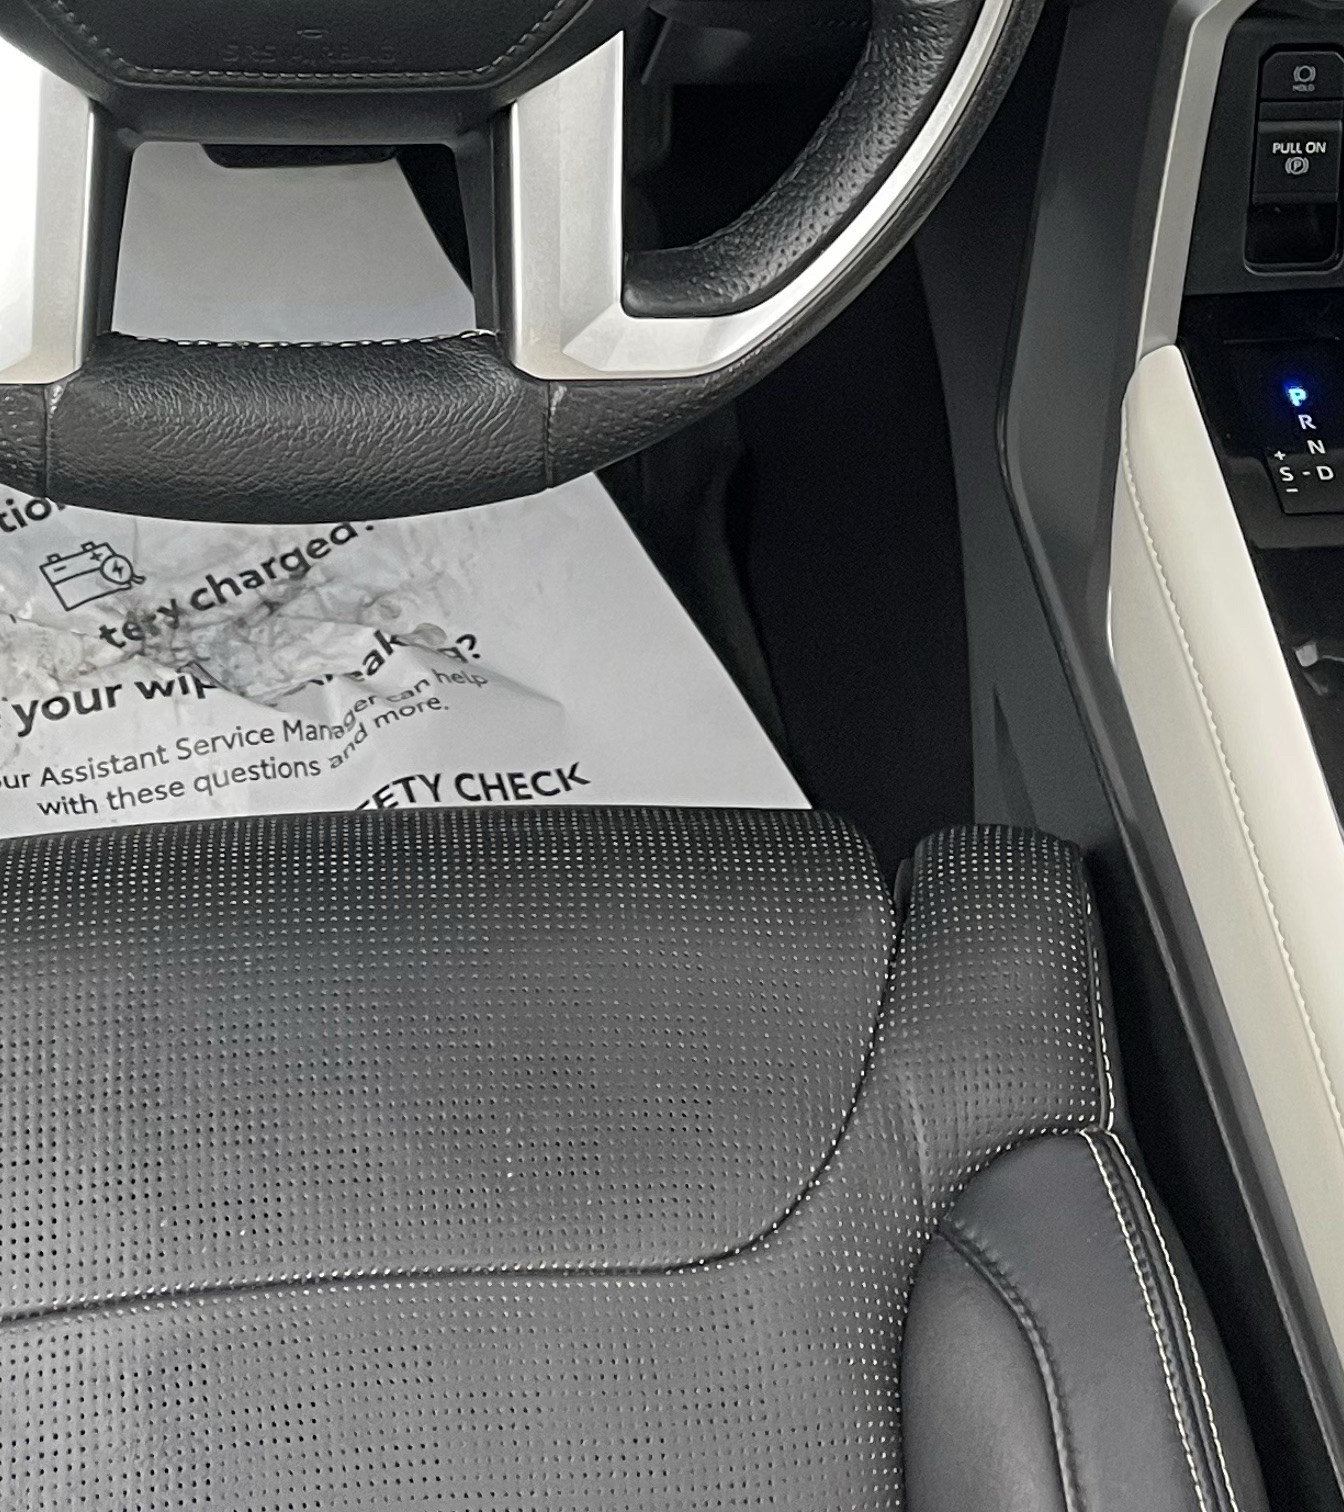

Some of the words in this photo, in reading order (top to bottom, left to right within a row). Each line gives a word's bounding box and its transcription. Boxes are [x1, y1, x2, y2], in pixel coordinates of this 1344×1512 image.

[1272, 142, 1303, 154] PULL
[1305, 141, 1327, 154] ON
[1288, 387, 1308, 407] P
[1297, 414, 1317, 430] R
[1307, 439, 1326, 455] N
[1280, 465, 1295, 482] S
[1317, 465, 1335, 481] D
[4, 680, 123, 738] your
[40, 744, 170, 788] Assistant
[176, 725, 276, 761] Service
[282, 694, 378, 742] Manager
[432, 668, 489, 688] help
[36, 792, 99, 817] with
[106, 778, 186, 812] these
[193, 756, 322, 797] questions
[329, 722, 369, 770] and
[373, 696, 450, 729] more.
[453, 761, 592, 802] CHECK
